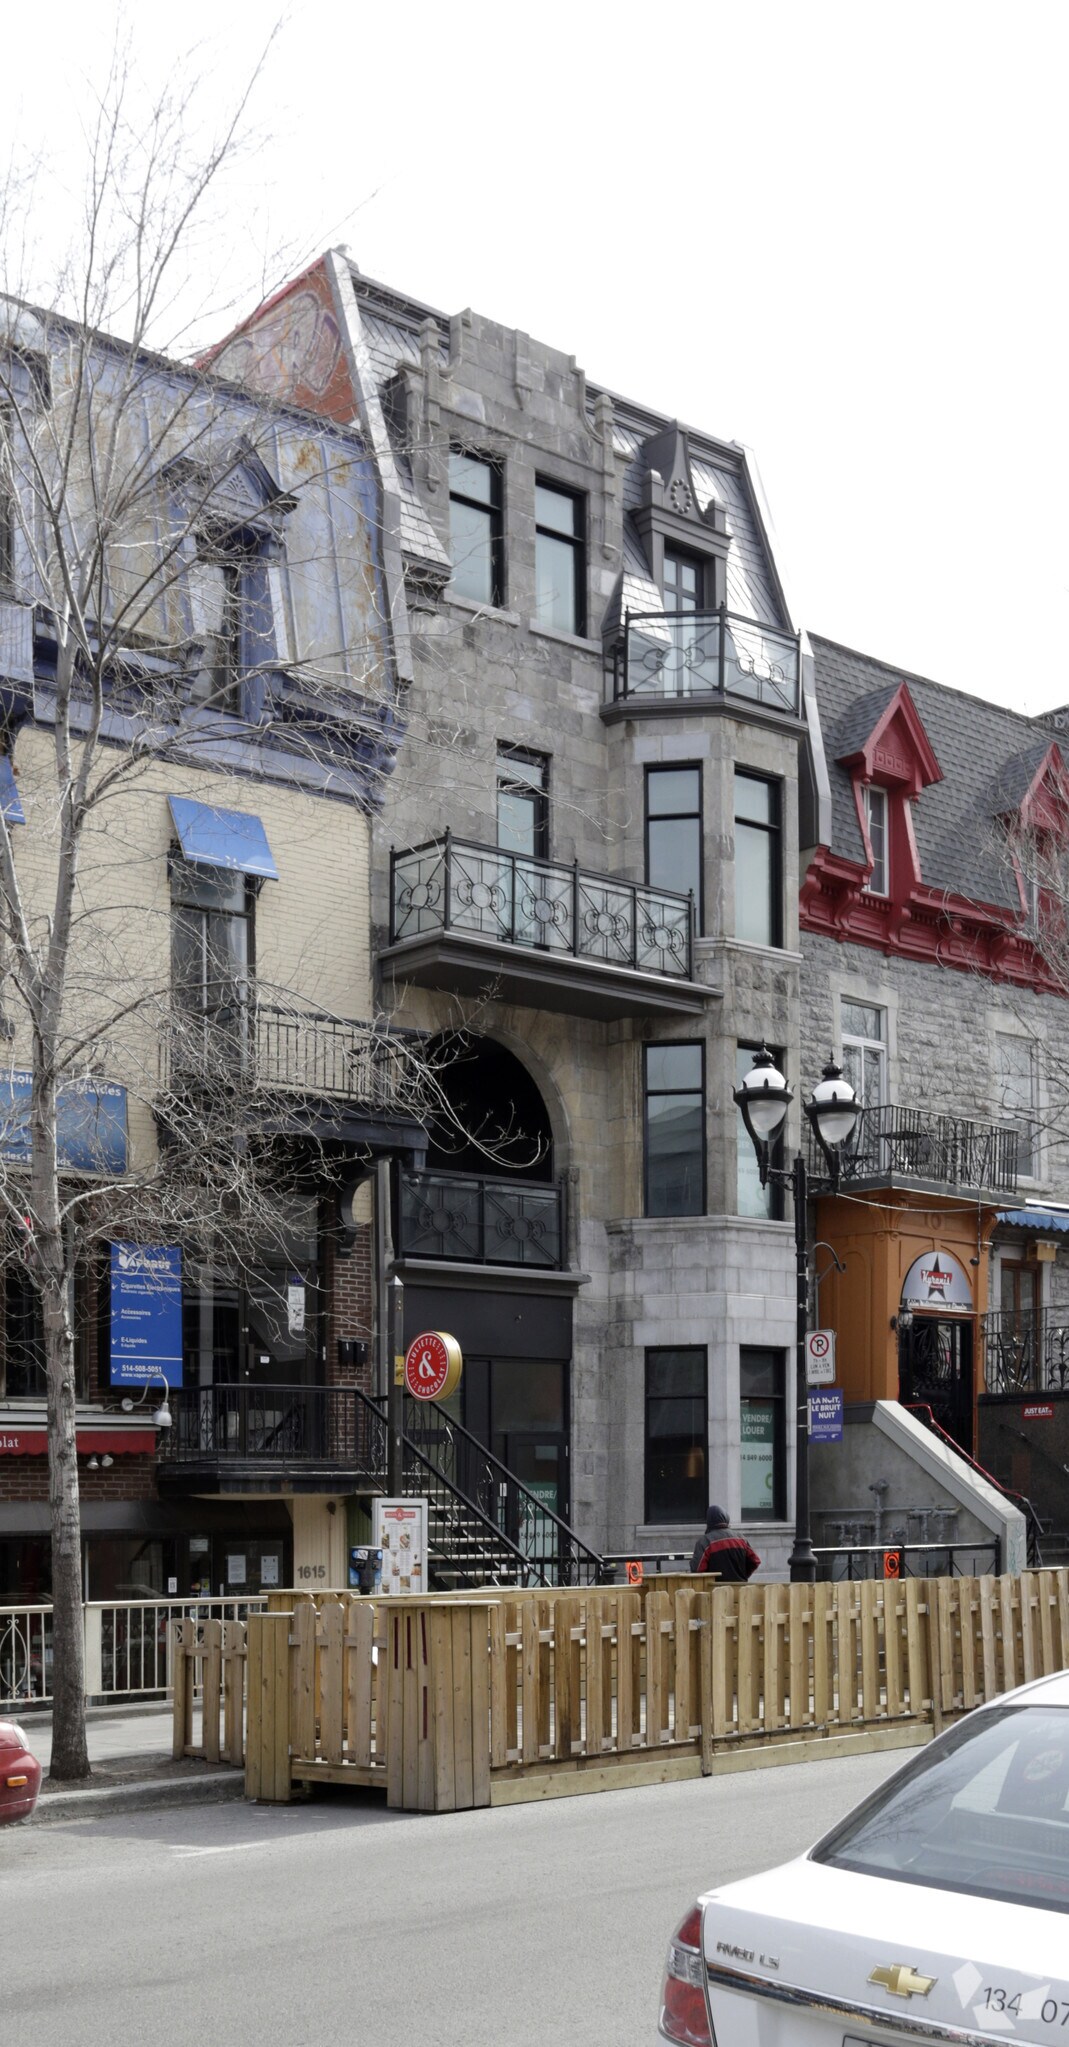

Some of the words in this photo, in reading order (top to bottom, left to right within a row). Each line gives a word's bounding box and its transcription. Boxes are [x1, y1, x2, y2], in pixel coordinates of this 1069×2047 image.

[361, 1342, 365, 1351] 2
[410, 1338, 437, 1364] JULIETTE
[418, 1350, 437, 1379] &
[417, 1367, 447, 1394] CHOCOLAT
[818, 1411, 836, 1419] NUIT
[1024, 1407, 1038, 1415] JUST
[742, 1413, 773, 1424] VENDRE/
[742, 1426, 765, 1435] LOUER
[297, 1565, 326, 1579] 1615
[717, 1941, 755, 1963] AVEO
[759, 1952, 780, 1970] LS
[983, 1986, 1023, 2017] 134
